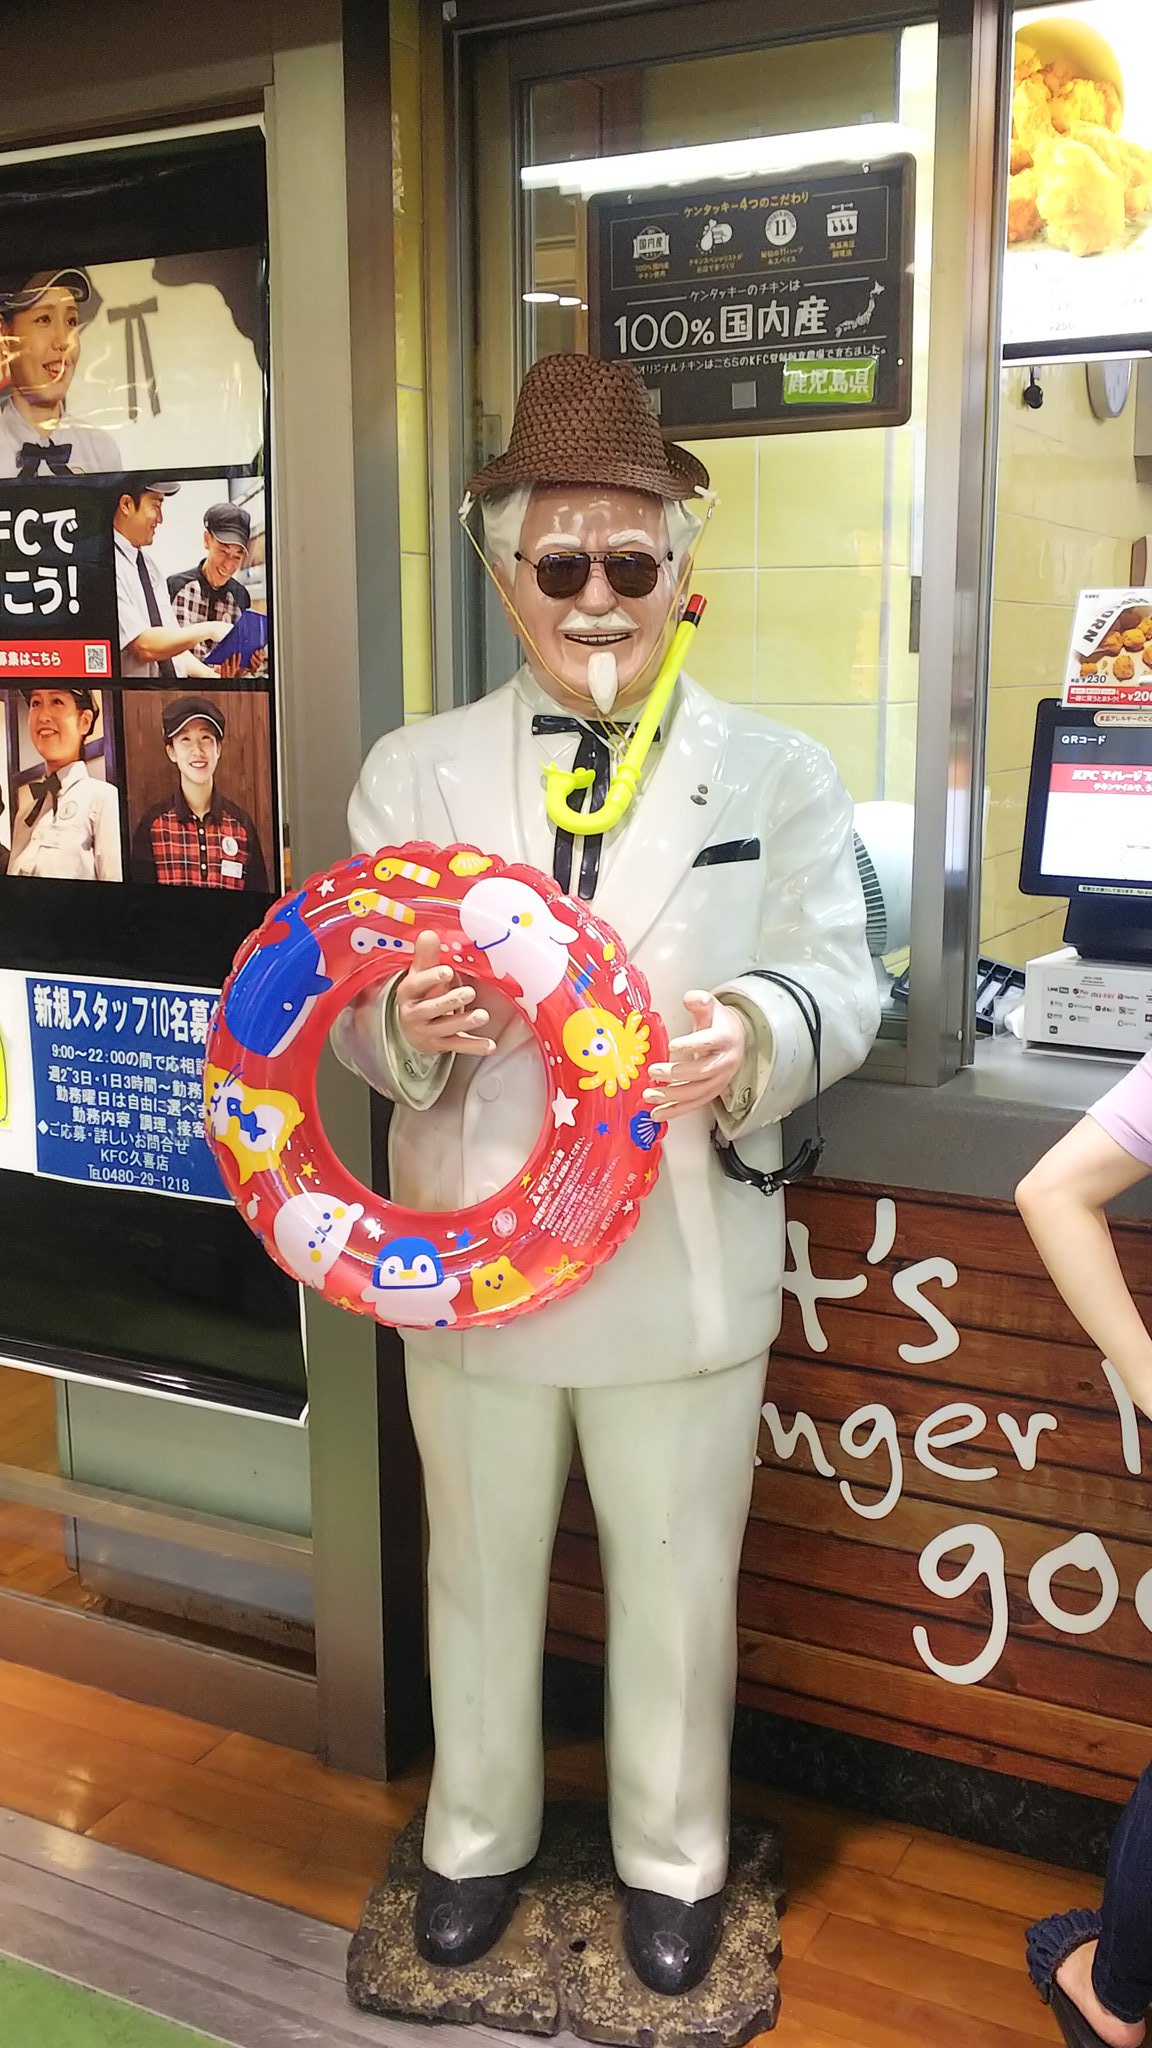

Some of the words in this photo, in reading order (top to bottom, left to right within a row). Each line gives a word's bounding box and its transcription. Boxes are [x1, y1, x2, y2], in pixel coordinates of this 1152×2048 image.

[684, 191, 809, 218] ケンタッキー4つのこだわり
[690, 279, 801, 302] ケンタッキーのチキンは
[613, 295, 830, 354] 100%国内産
[786, 369, 870, 395] 鹿児島県
[1127, 691, 1152, 702] ¥20
[1061, 735, 1106, 745] QRコード
[72, 1106, 131, 1129] 勤務内容
[100, 1148, 169, 1171] KFC久喜店
